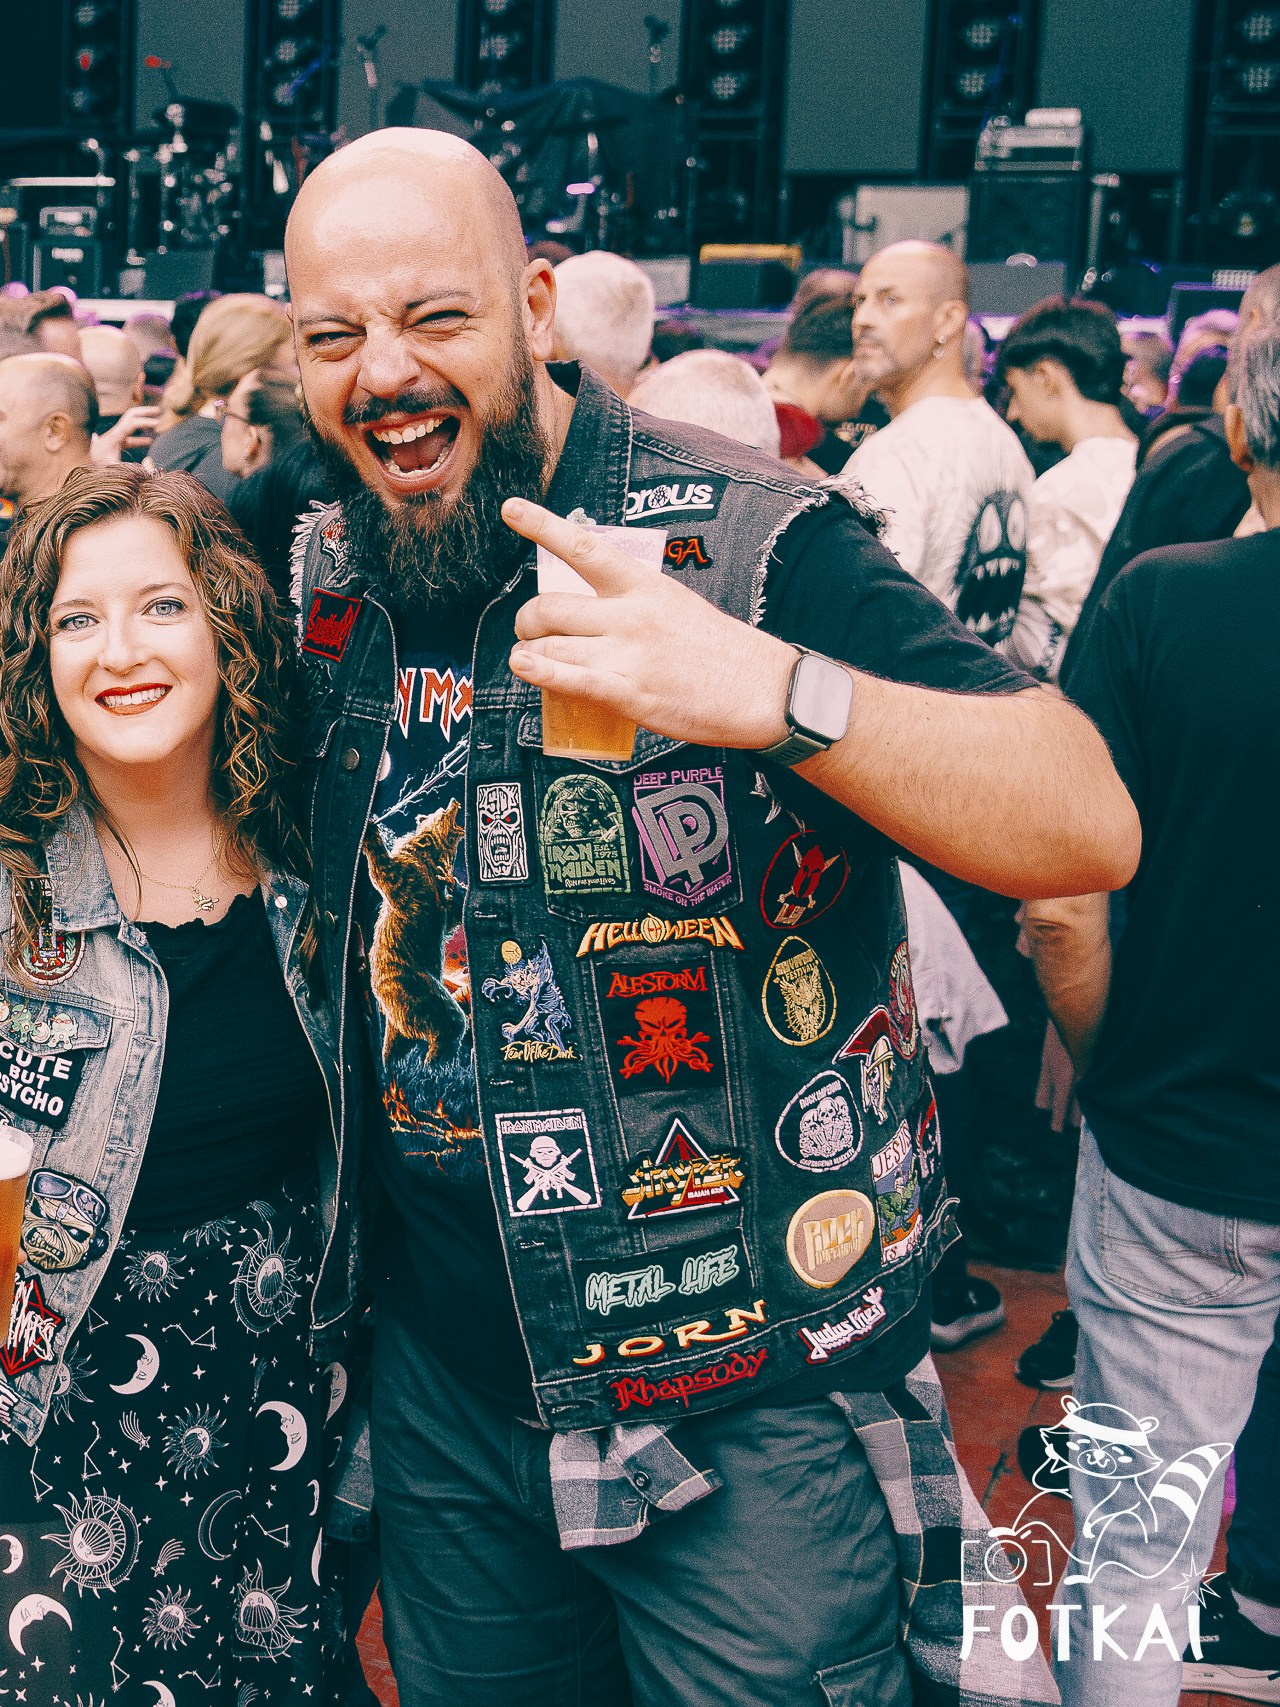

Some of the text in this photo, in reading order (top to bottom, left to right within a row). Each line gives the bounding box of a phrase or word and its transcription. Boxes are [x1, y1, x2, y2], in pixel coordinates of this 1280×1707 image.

[627, 484, 714, 515] prous
[633, 766, 724, 786] DEEP PURPLE
[547, 843, 594, 865] IRON
[547, 859, 622, 882] MAIDEN
[594, 850, 619, 859] 1975
[643, 875, 732, 908] SMOKE ON THE WATER
[575, 912, 746, 958] HELLOWEEN
[605, 966, 709, 999] ALESTORM
[8, 1063, 51, 1090] BUT
[873, 1124, 912, 1179] JESUS
[687, 1188, 711, 1199] ISAIAH
[802, 1207, 864, 1271] ROCK
[585, 1244, 740, 1315] METAL LIFE
[572, 1299, 767, 1367] JORN
[609, 1347, 769, 1412] Rhapsody
